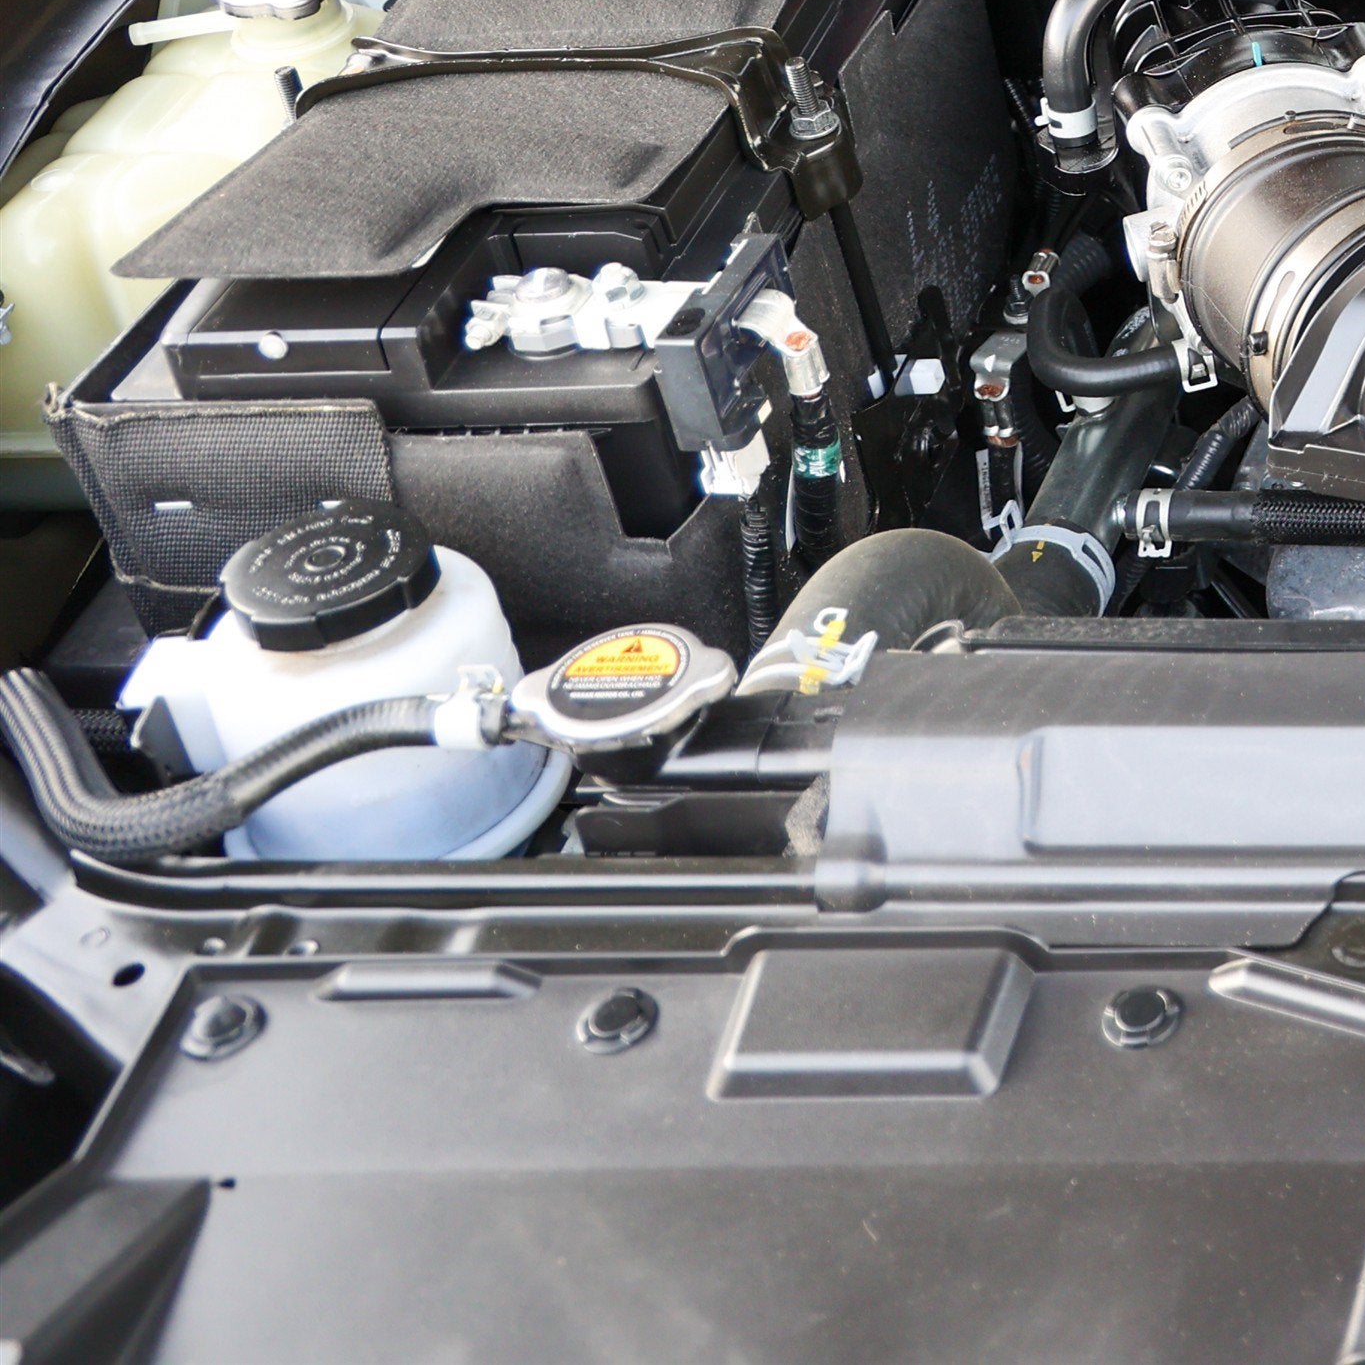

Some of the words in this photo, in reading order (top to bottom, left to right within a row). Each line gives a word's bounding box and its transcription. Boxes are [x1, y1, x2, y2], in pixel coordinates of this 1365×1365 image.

[596, 654, 660, 663] WARNING
[575, 663, 670, 672] AVERTISSEMENT
[594, 675, 618, 683] OPEN
